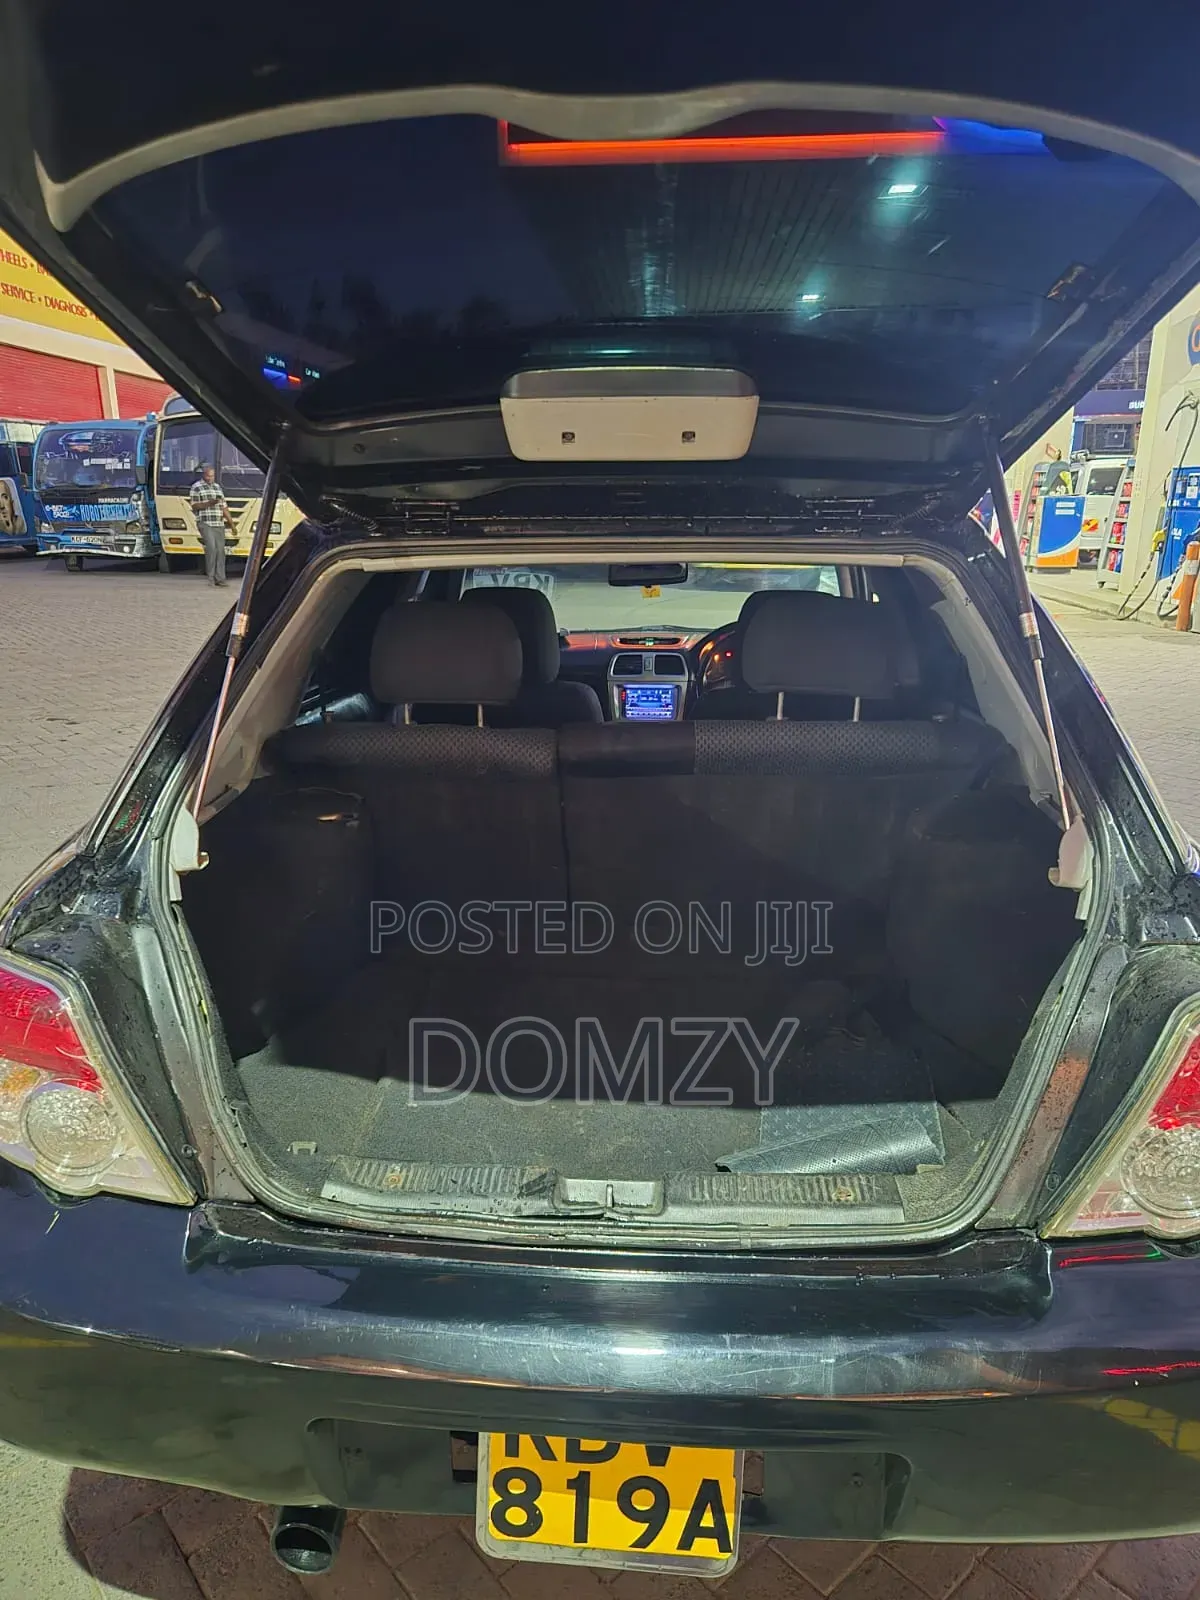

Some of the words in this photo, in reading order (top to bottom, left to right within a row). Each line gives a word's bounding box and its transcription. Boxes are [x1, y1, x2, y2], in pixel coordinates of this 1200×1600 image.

[0, 249, 28, 269] HEELS
[0, 282, 36, 304] SERVICE
[44, 295, 88, 318] DIAGNOSIS
[490, 1467, 733, 1553] 819A
